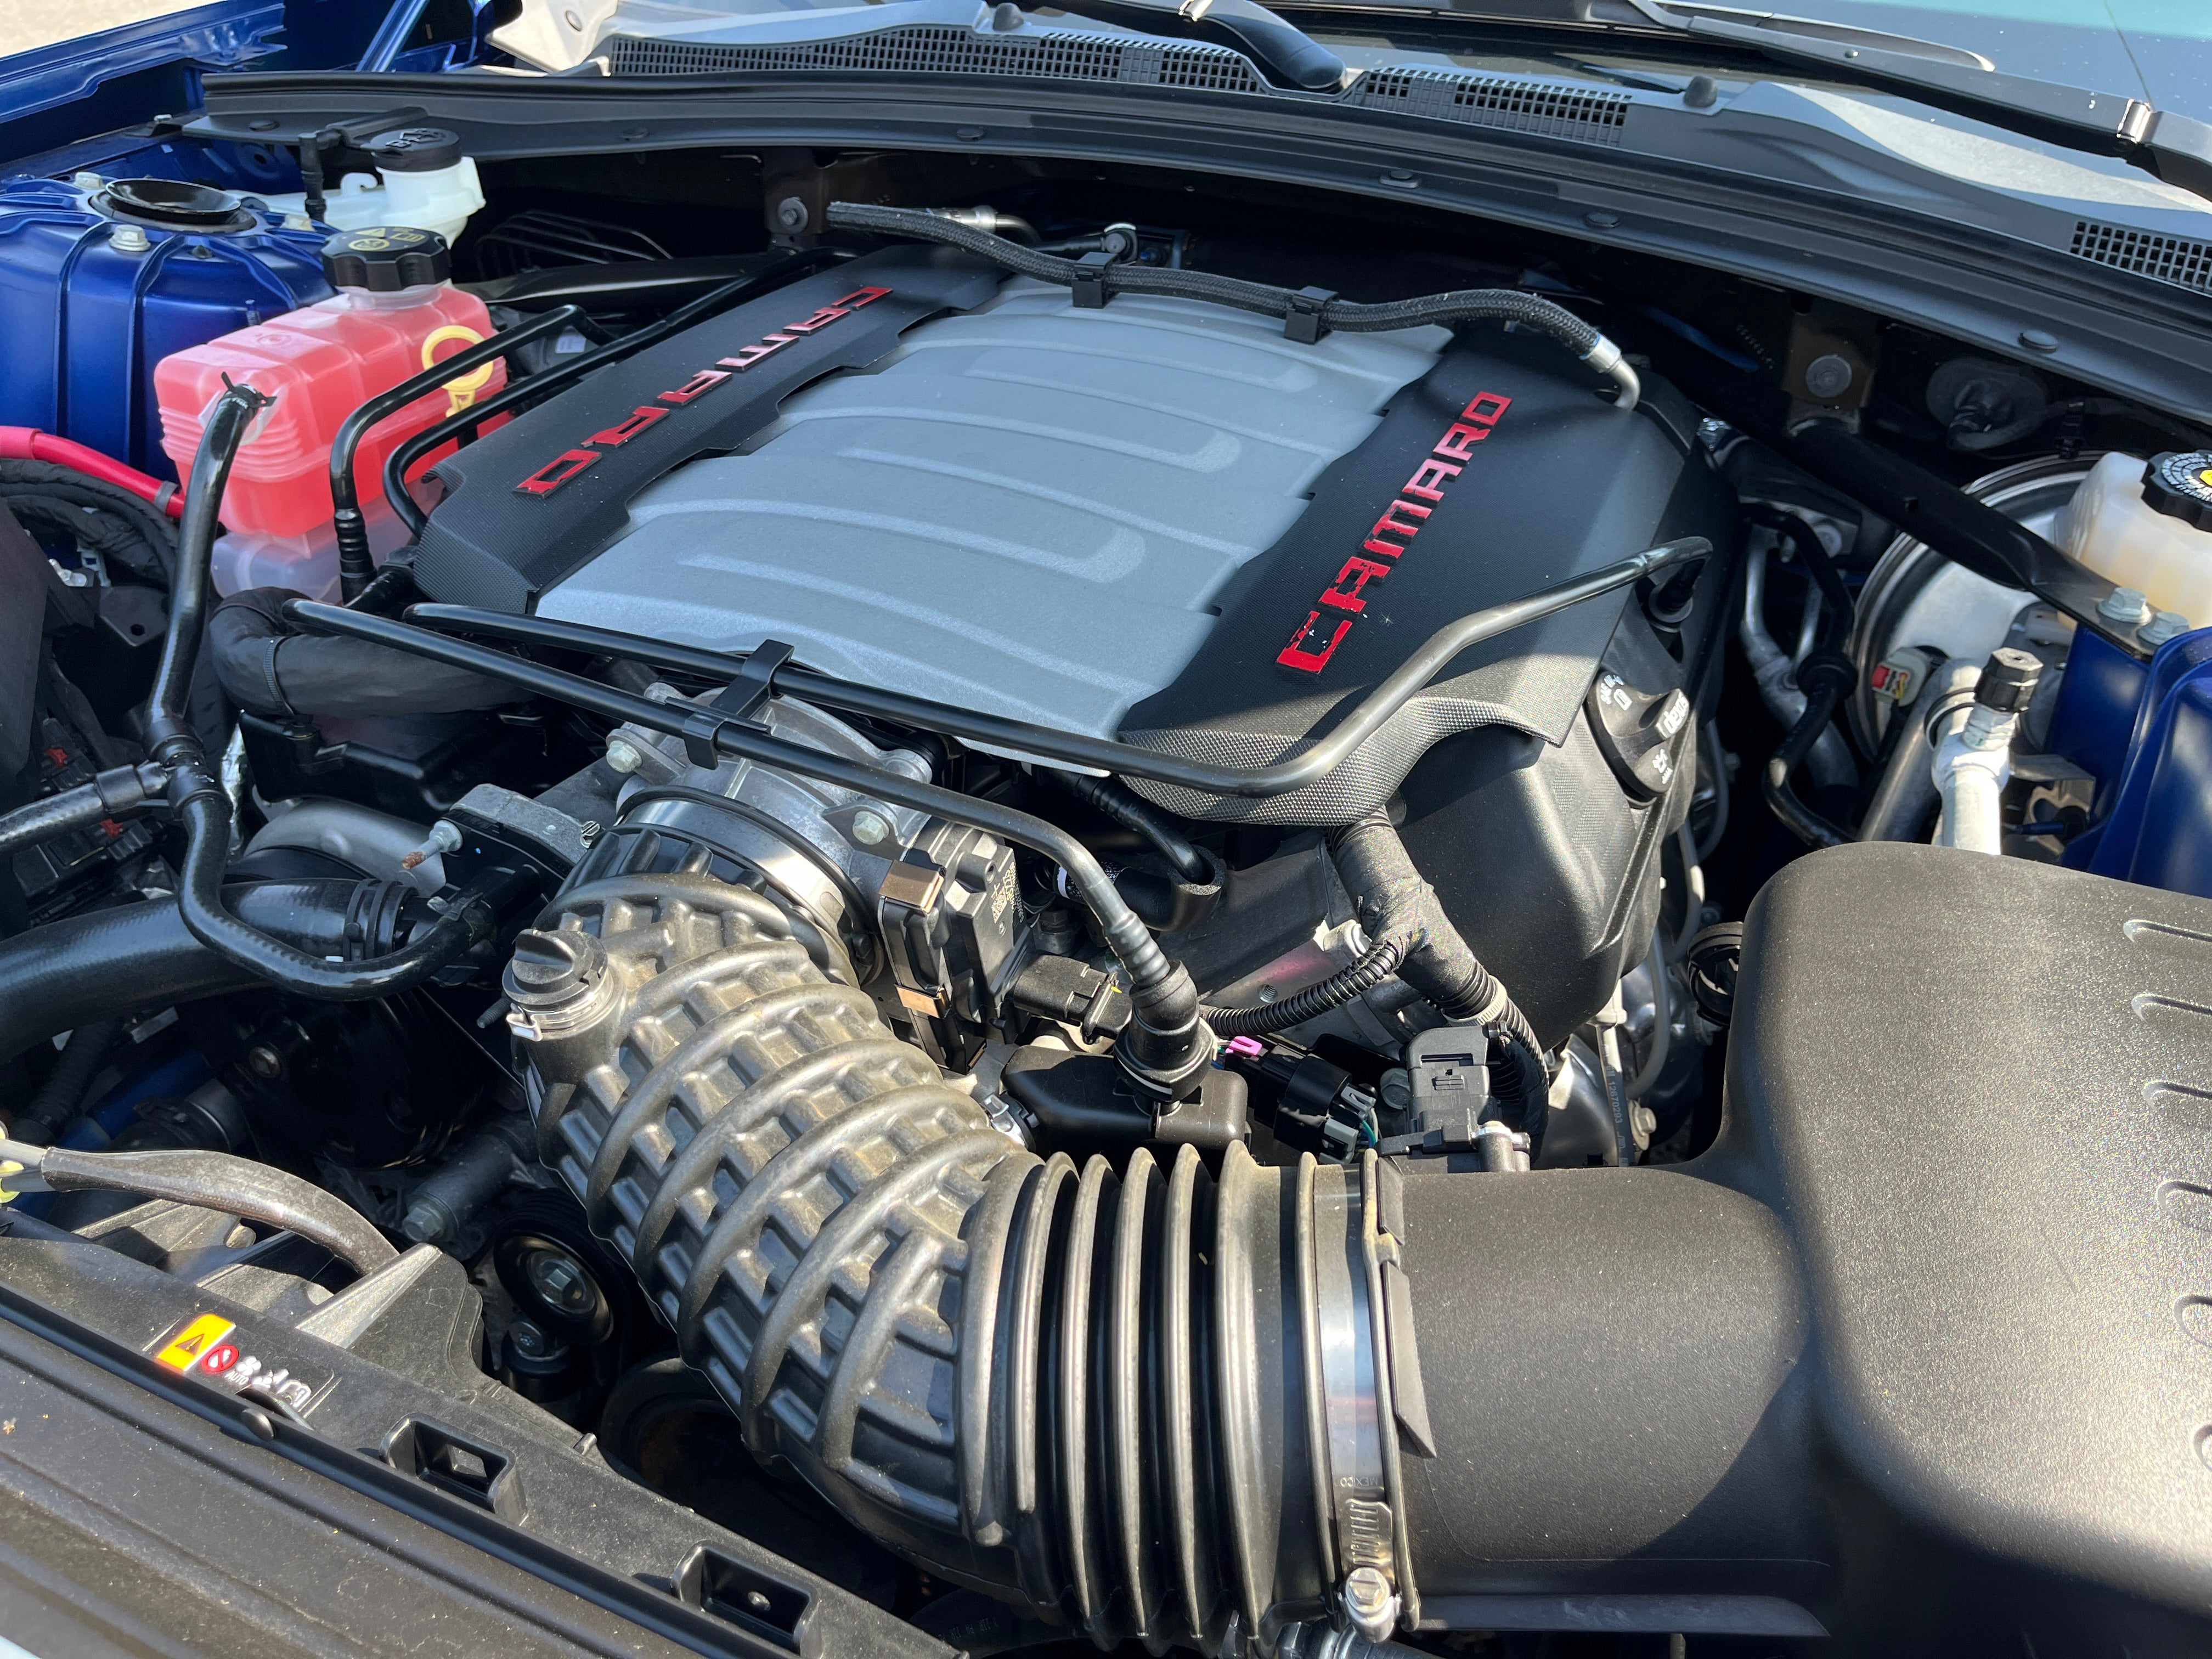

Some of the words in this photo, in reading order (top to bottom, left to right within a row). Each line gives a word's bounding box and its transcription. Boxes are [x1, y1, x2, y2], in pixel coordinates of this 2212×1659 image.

[514, 286, 893, 498] CAMARO
[1276, 391, 1514, 674] CAMARO
[1608, 1081, 1622, 1124] 12670293
[224, 1370, 249, 1385] AUTO
[1340, 1477, 1378, 1487] MEXICO
